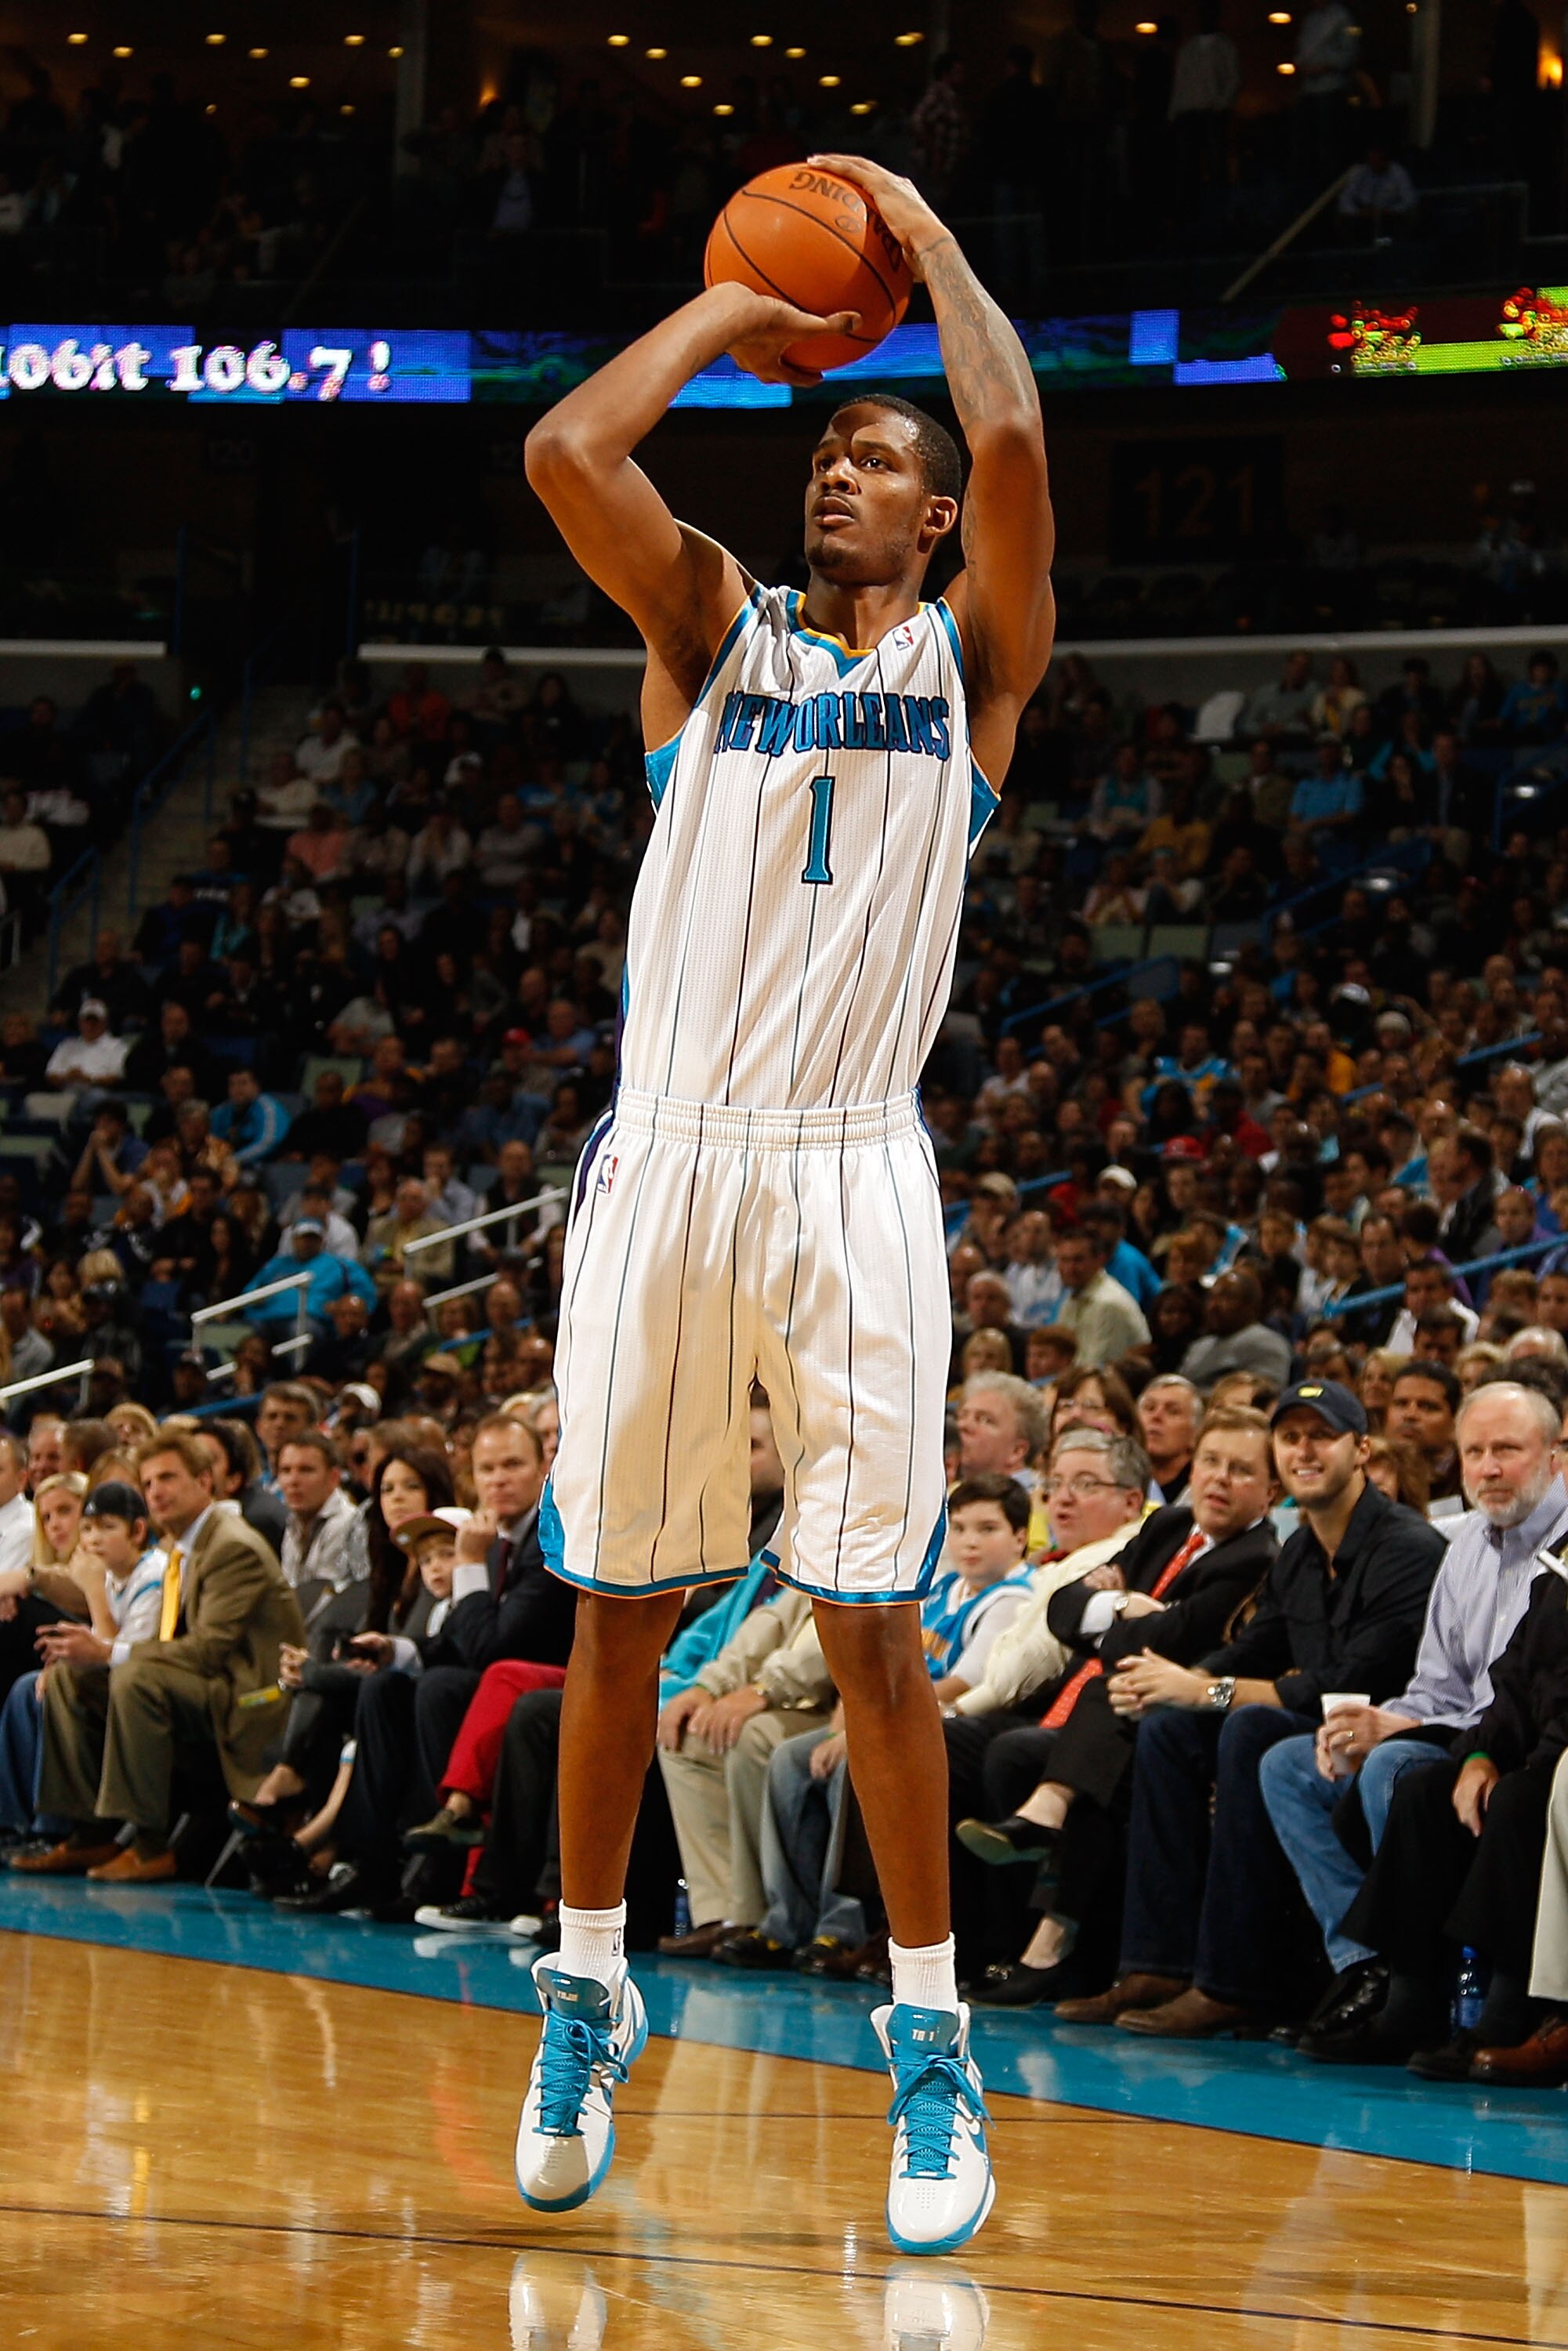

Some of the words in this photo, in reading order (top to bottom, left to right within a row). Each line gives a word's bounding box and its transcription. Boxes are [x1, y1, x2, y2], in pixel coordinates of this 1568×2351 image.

[169, 340, 353, 402] 106.7
[1133, 462, 1254, 541] 121
[801, 776, 836, 885] 1
